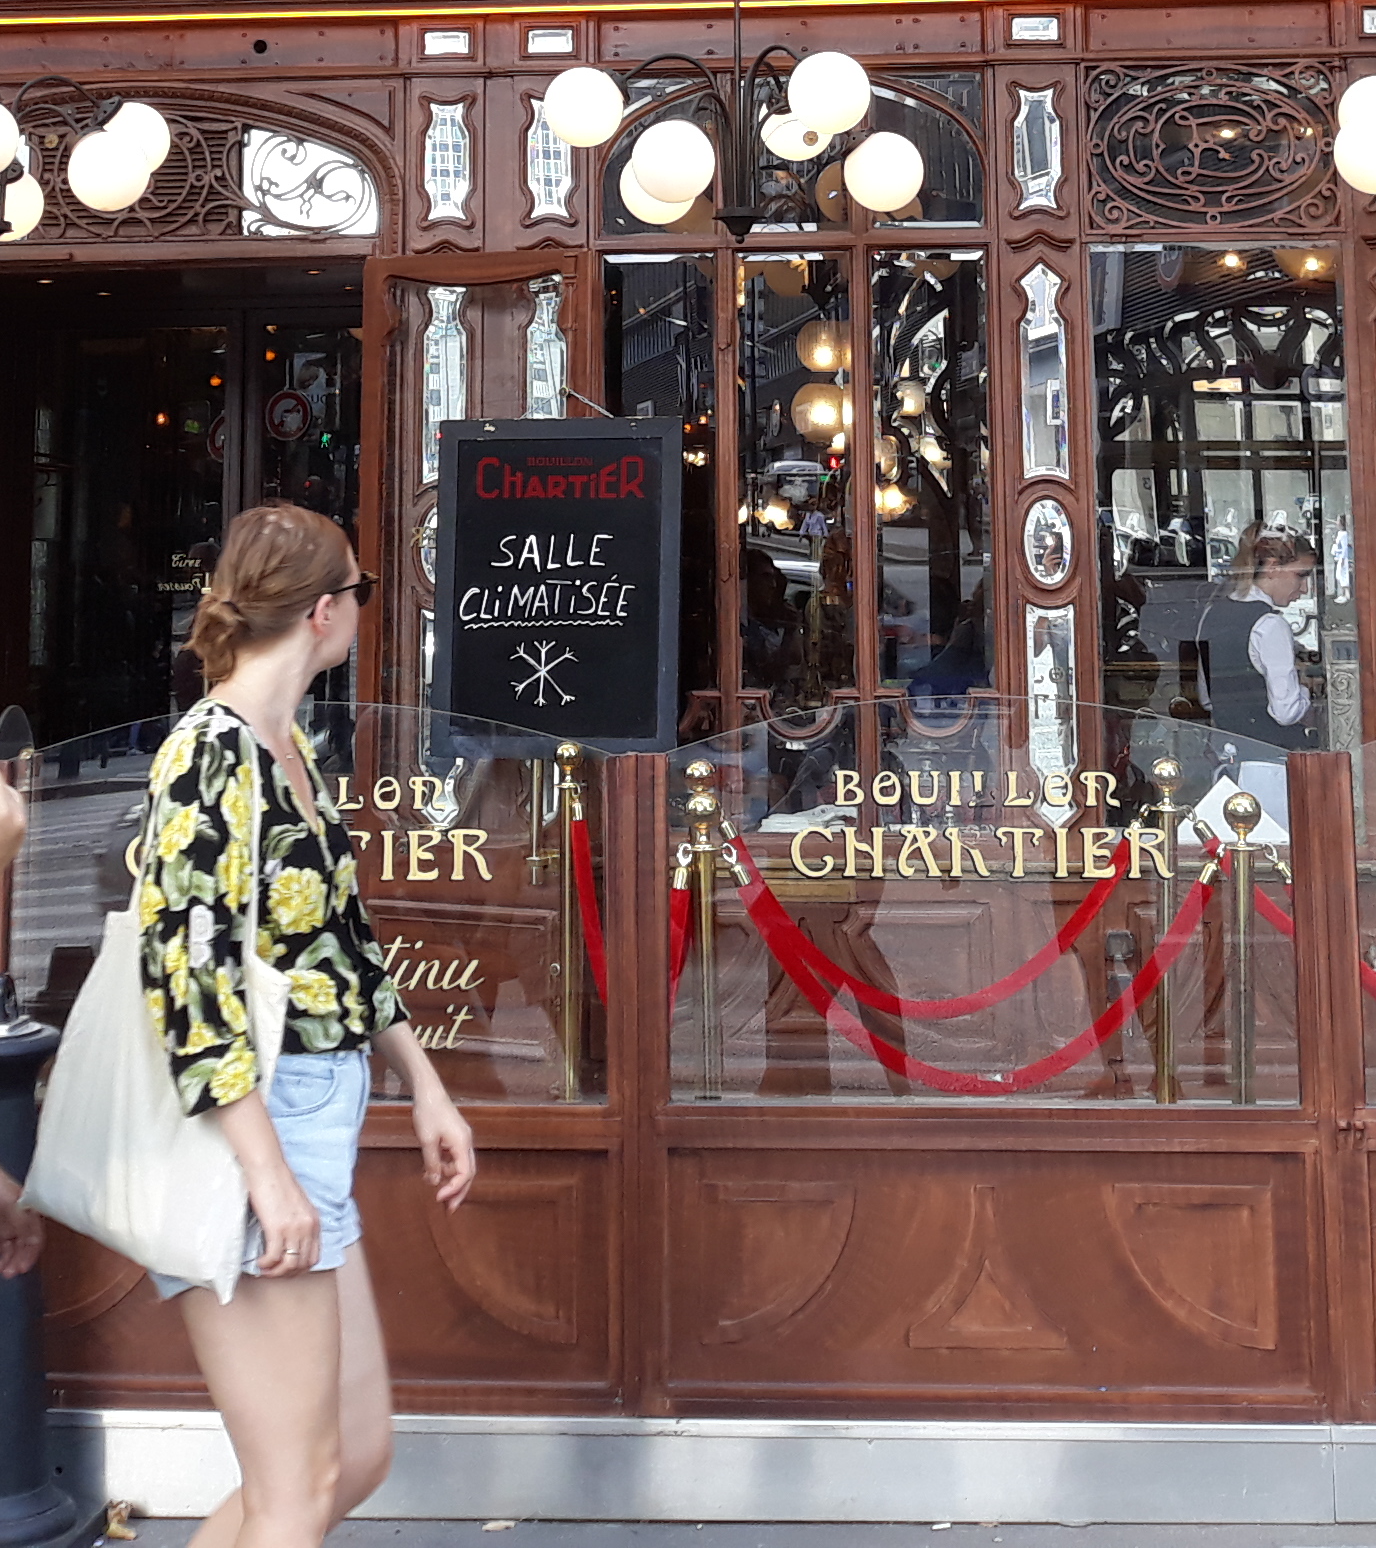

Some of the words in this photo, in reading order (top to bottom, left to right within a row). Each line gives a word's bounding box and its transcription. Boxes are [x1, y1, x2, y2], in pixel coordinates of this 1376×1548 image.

[526, 456, 595, 467] BOUILLON
[491, 533, 614, 573] SALLE
[832, 769, 1122, 809] BOUILLON
[789, 825, 1176, 880] CHARTIER
[383, 936, 488, 992] tinu
